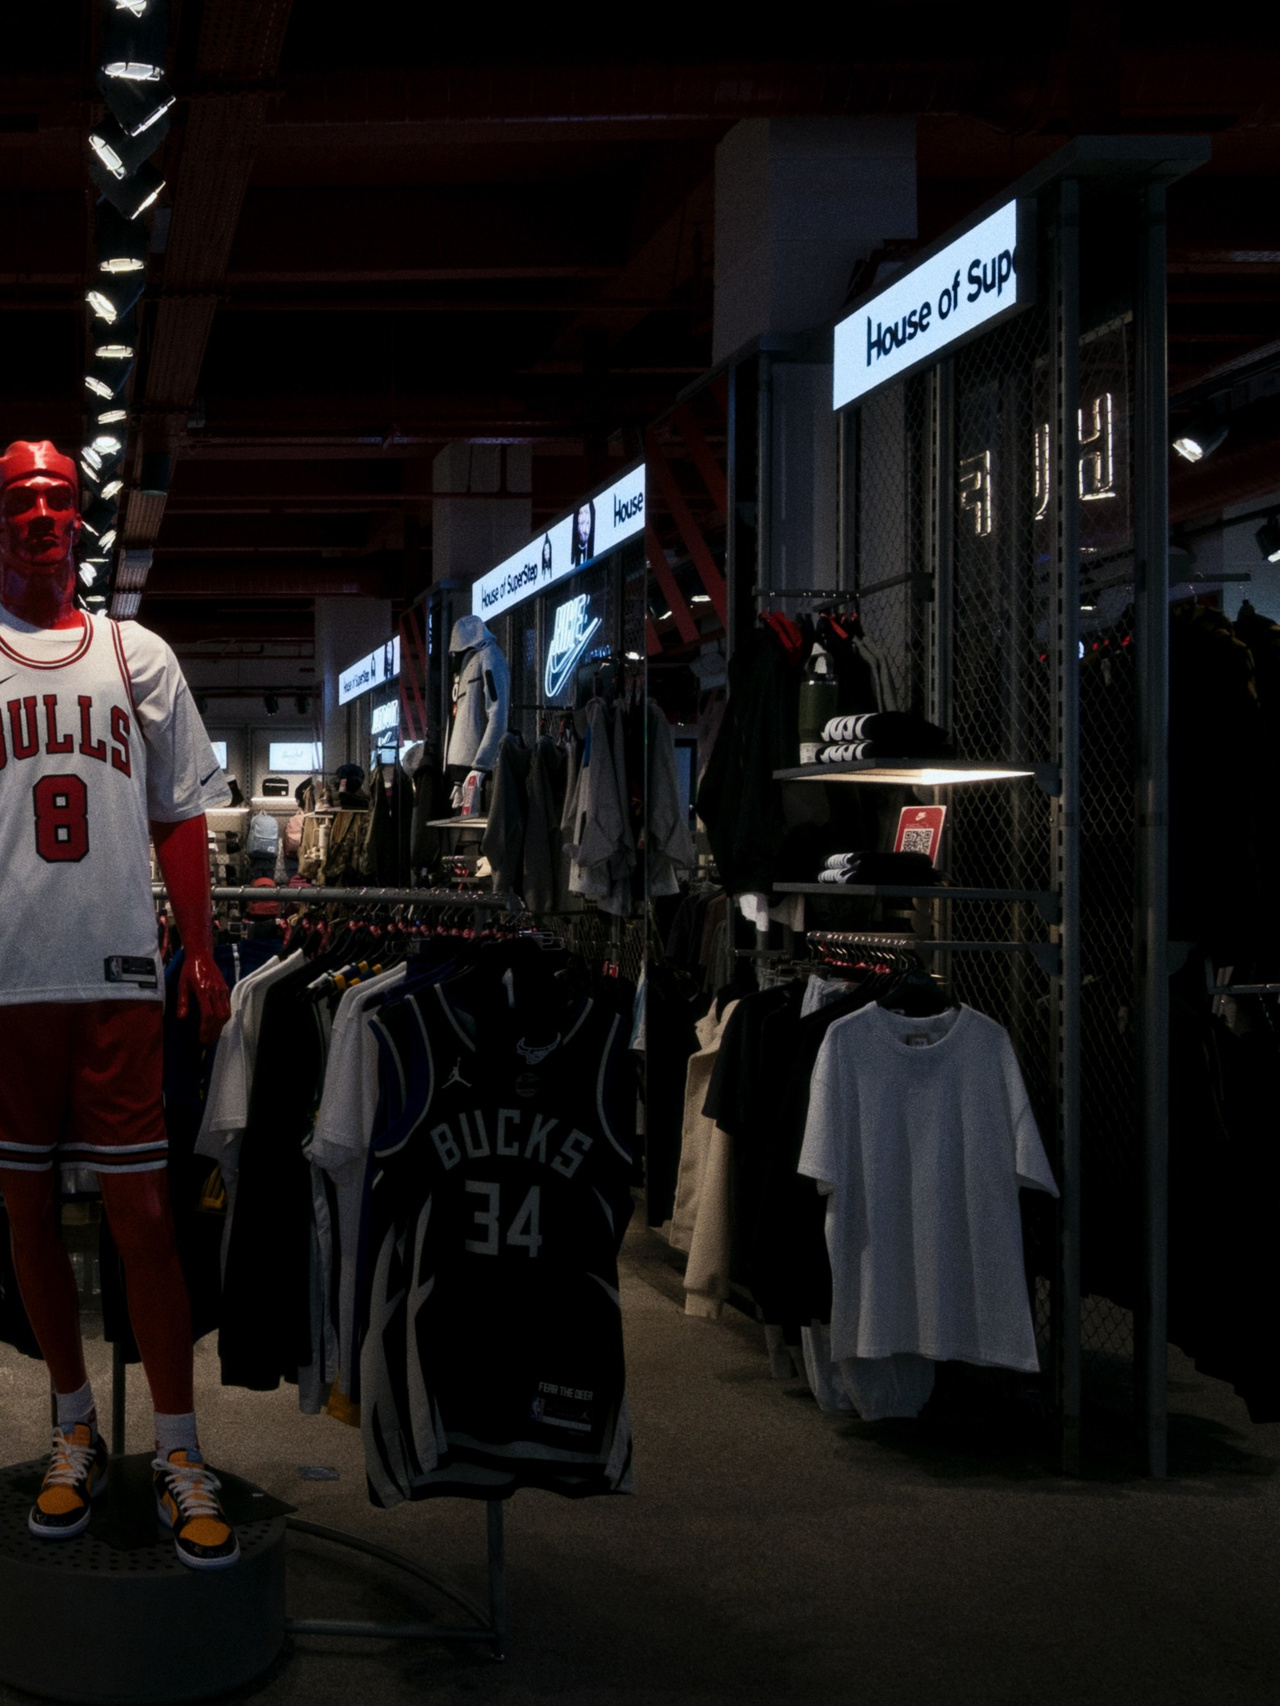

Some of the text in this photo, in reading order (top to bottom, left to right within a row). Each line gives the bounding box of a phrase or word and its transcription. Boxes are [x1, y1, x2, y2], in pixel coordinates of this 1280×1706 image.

[867, 301, 931, 366] House
[937, 269, 961, 321] of
[613, 492, 644, 528] House
[481, 584, 499, 610] House
[500, 575, 508, 599] of
[33, 774, 89, 862] 8
[429, 1108, 594, 1179] BUCKS
[464, 1180, 544, 1258] 34
[538, 1381, 594, 1401] FEAR THE DEER
